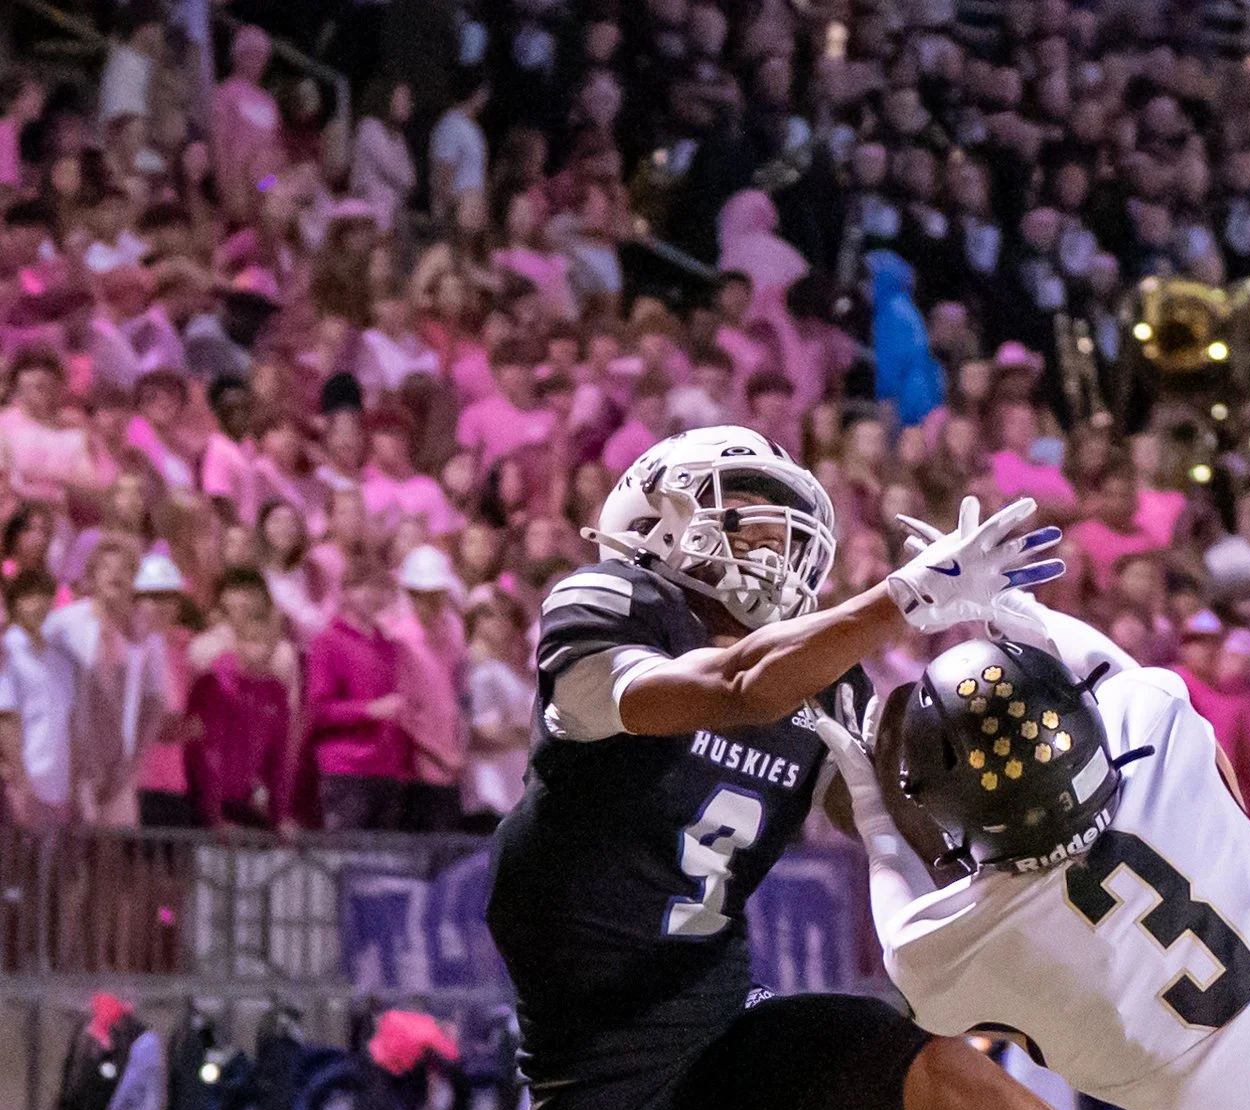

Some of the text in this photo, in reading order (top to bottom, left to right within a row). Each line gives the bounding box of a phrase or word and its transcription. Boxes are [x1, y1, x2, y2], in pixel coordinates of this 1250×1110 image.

[690, 730, 800, 788] HUSKIES
[661, 783, 767, 942] 9
[1015, 808, 1112, 872] Riddell
